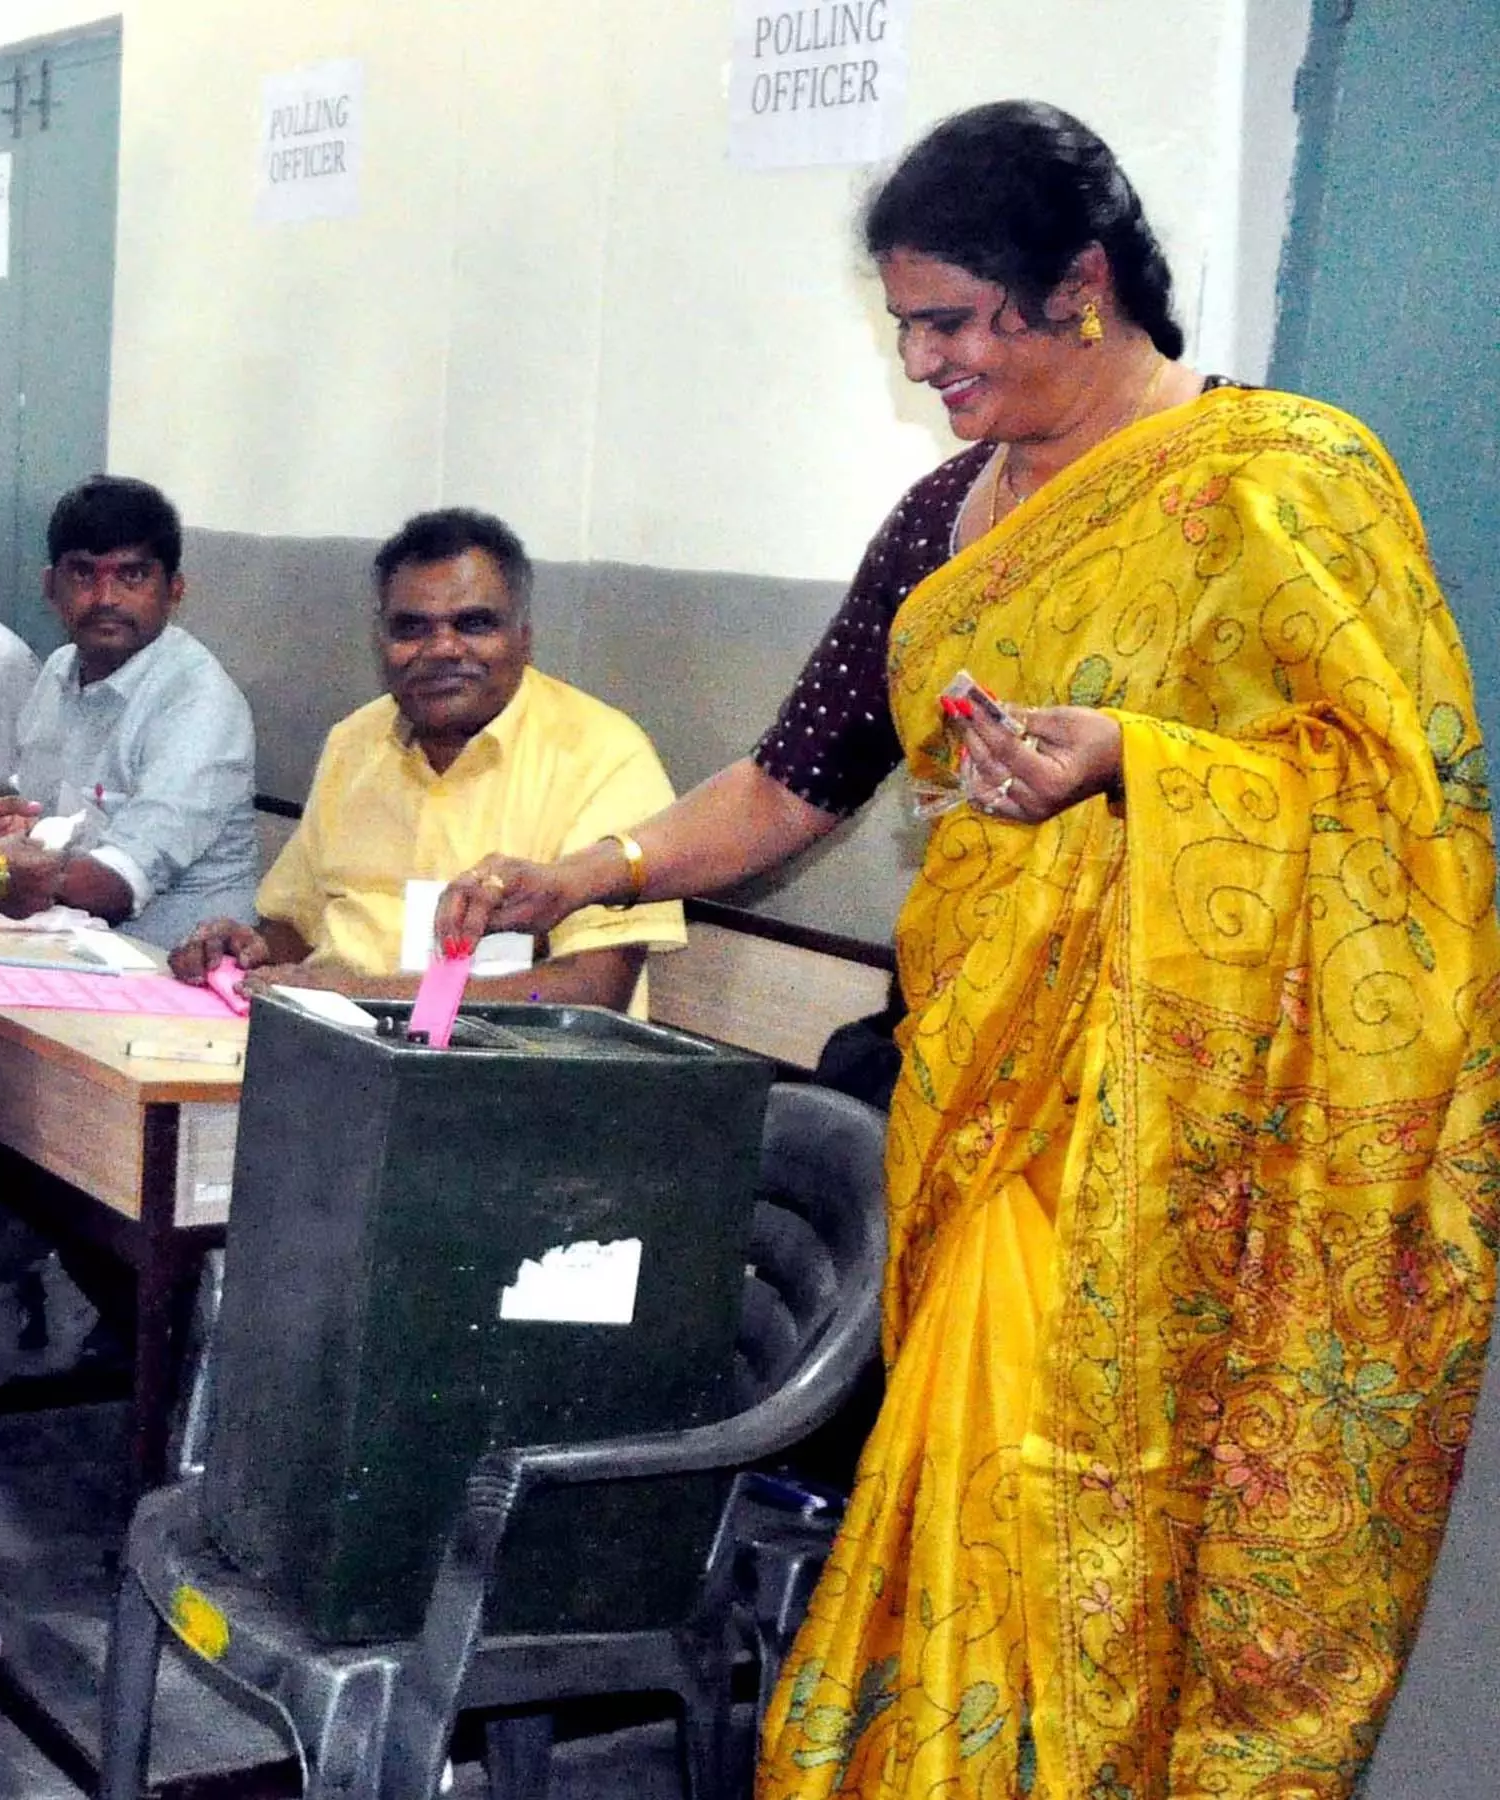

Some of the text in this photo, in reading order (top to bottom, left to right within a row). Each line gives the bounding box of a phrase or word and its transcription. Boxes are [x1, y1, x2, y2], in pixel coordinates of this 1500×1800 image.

[753, 0, 888, 58] POLLING
[751, 59, 879, 115] OFFICER
[269, 93, 349, 140] POLLING
[269, 140, 347, 184] OFFICER
